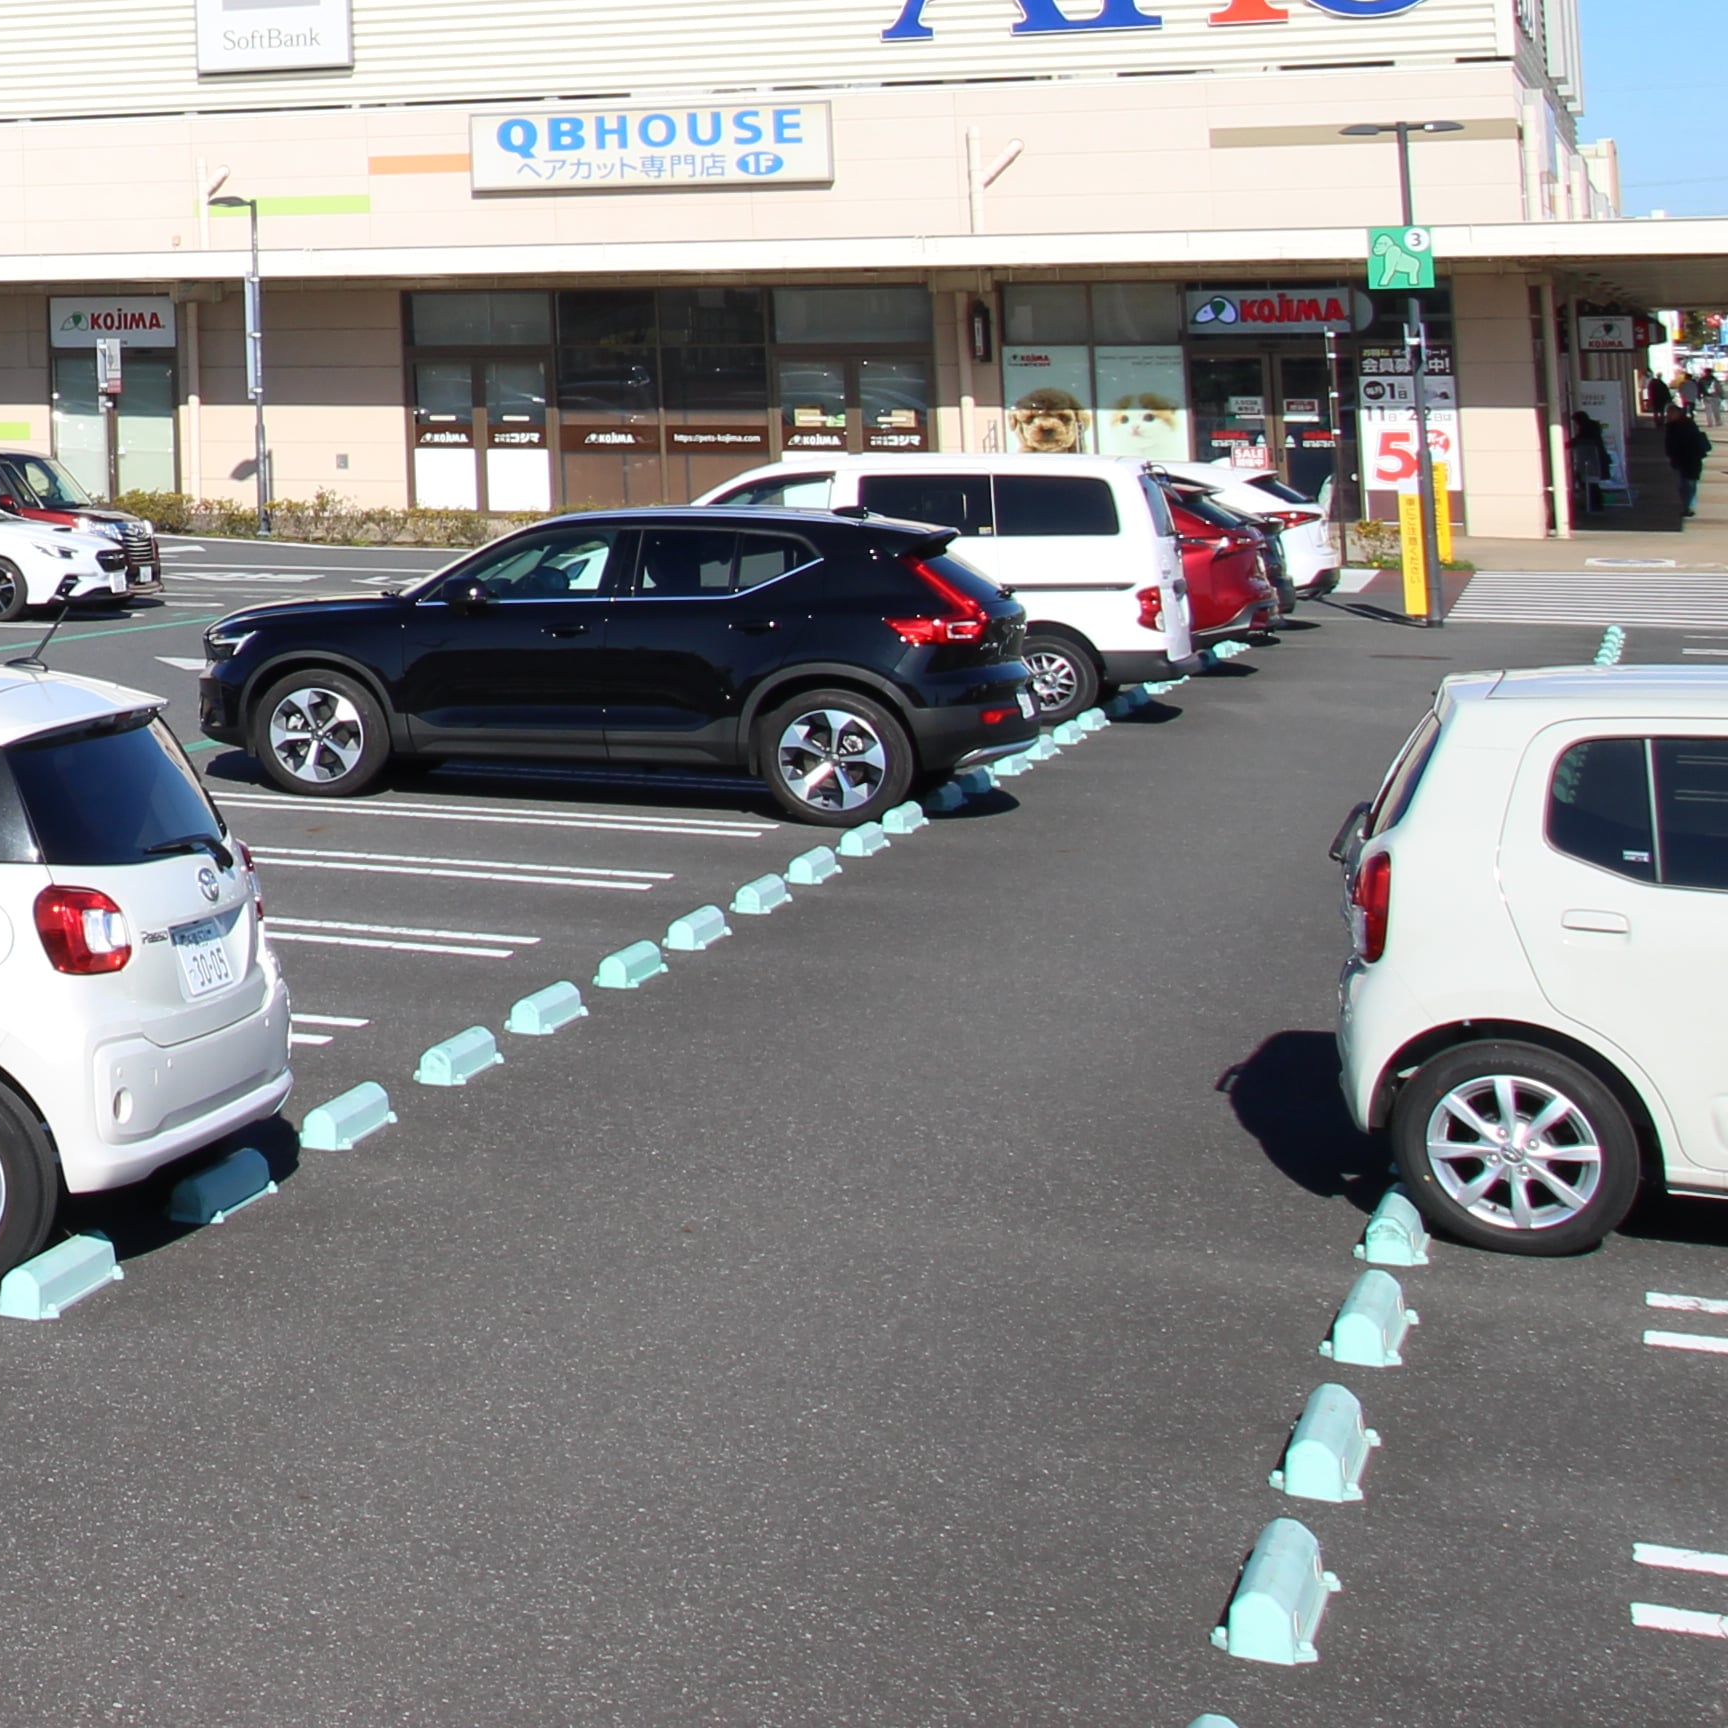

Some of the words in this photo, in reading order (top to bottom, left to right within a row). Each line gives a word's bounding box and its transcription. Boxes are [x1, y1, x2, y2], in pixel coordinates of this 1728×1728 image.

[222, 26, 321, 51] SoftBank
[516, 153, 727, 181] ヘアカット専門店
[745, 154, 775, 175] 1F
[1410, 232, 1422, 247] 3
[1362, 357, 1450, 373] 会員募中!
[1234, 448, 1265, 458] SALE
[1376, 430, 1421, 482] 5
[191, 947, 229, 987] 30-05
